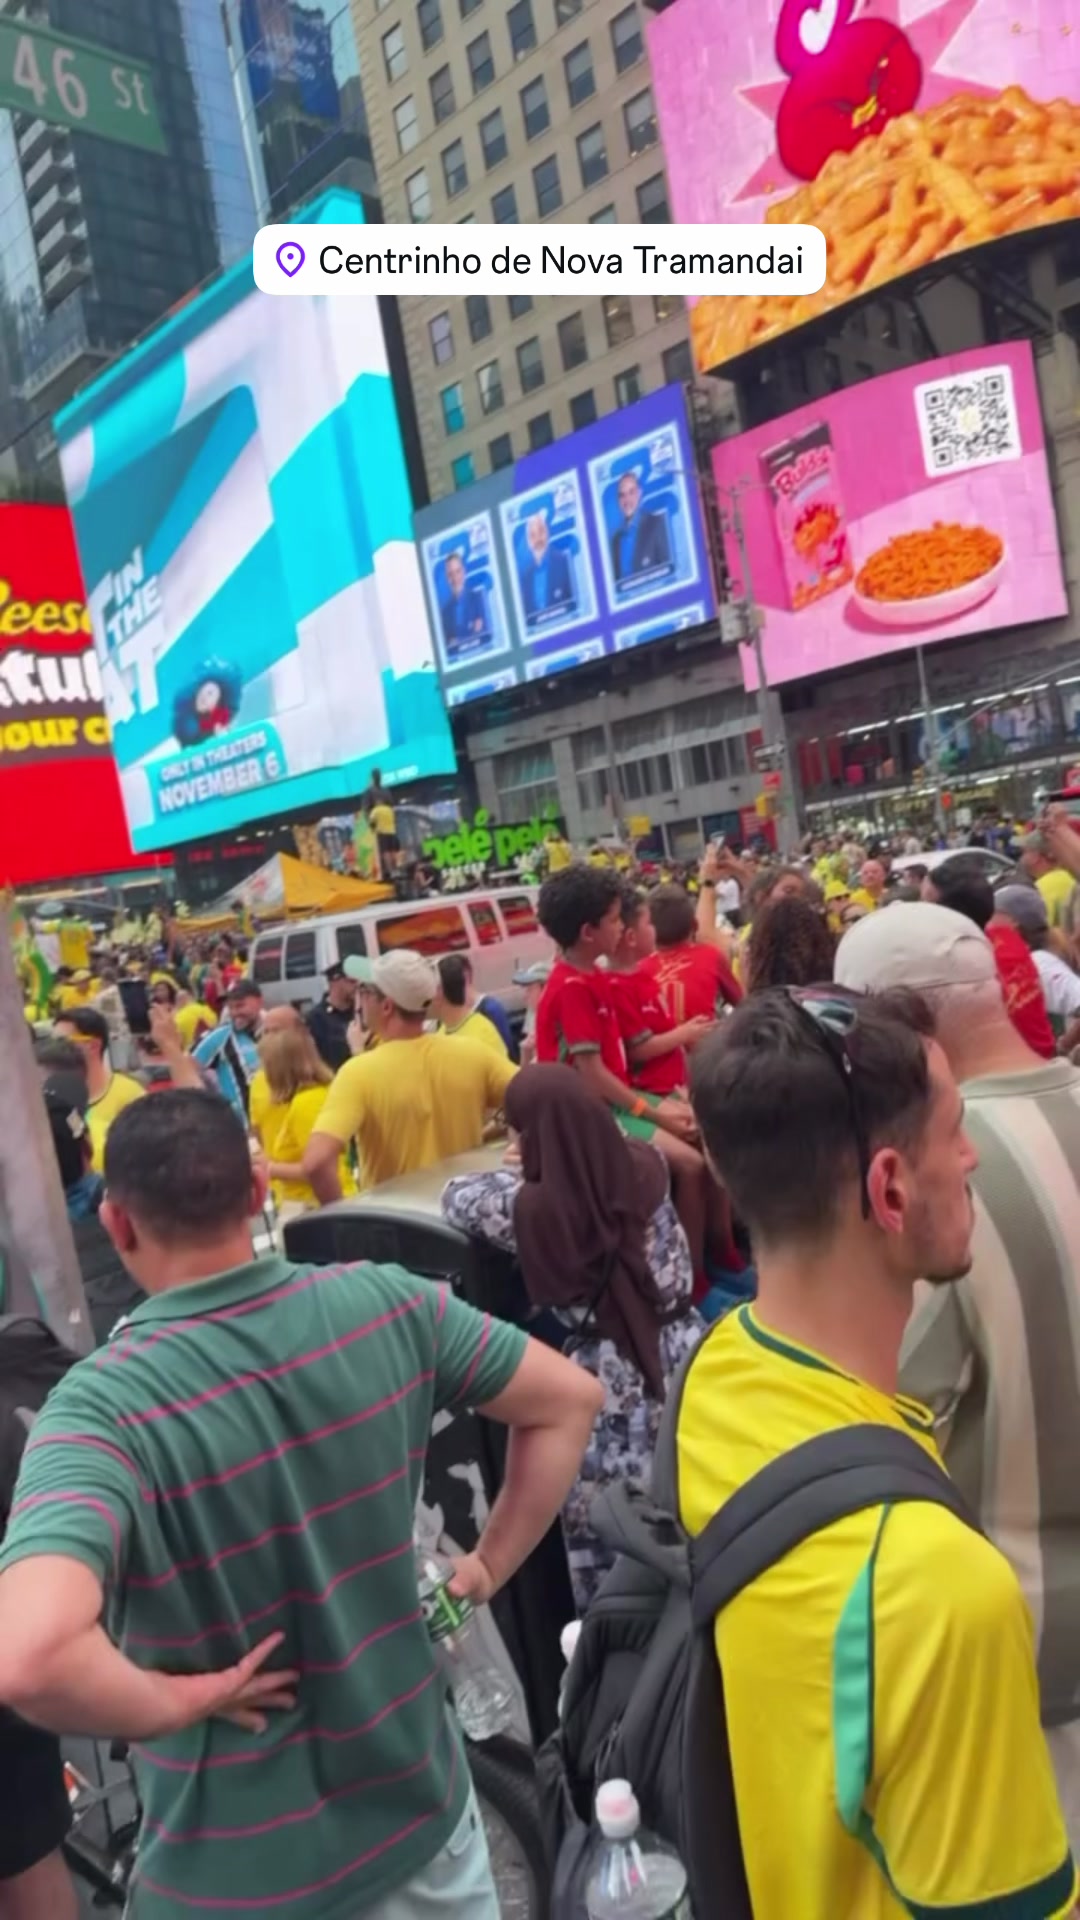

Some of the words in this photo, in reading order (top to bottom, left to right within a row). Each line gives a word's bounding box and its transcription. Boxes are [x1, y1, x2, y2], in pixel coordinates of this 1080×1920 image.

[13, 35, 88, 119] 46
[110, 67, 149, 115] St
[114, 545, 144, 607] IN
[107, 575, 162, 646] THE
[159, 757, 261, 813] NOVEMBER
[265, 751, 279, 779] 6
